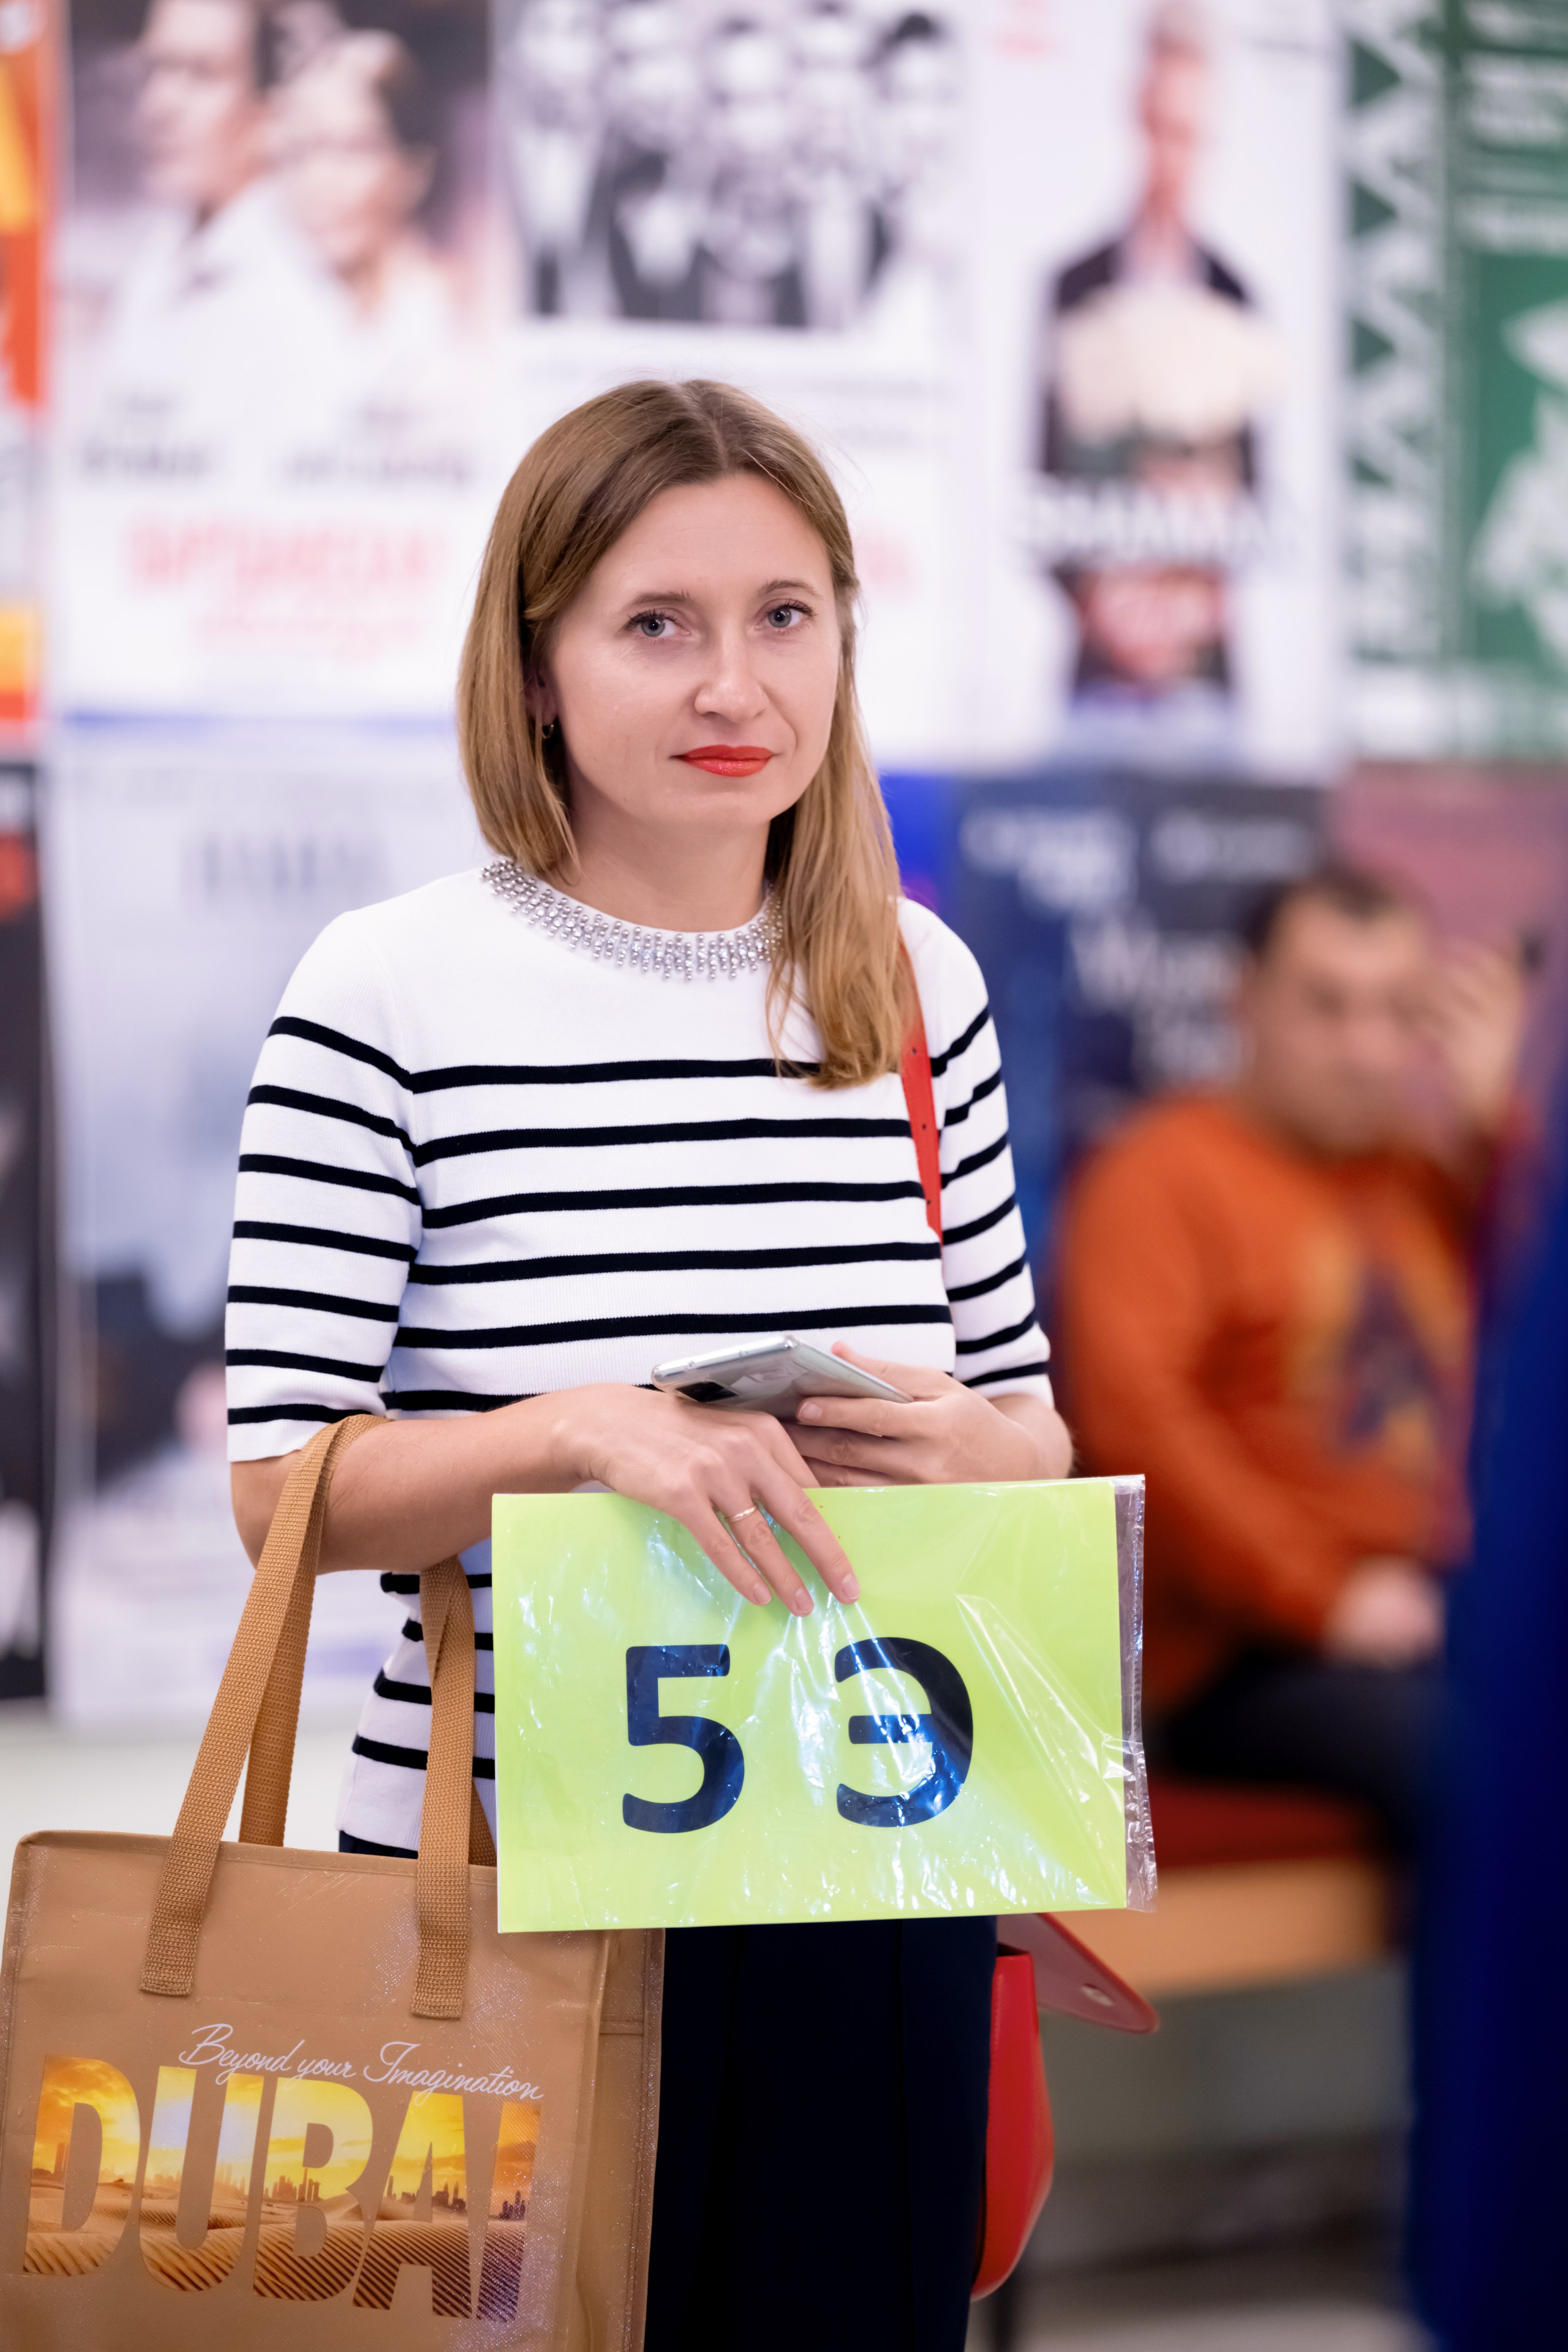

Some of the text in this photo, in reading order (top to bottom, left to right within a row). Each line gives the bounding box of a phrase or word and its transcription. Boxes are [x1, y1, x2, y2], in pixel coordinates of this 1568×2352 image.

[622, 1637, 974, 1834] 5 Э
[178, 2023, 545, 2106] Beyond your Imagination
[23, 2054, 543, 2322] DUBAI
